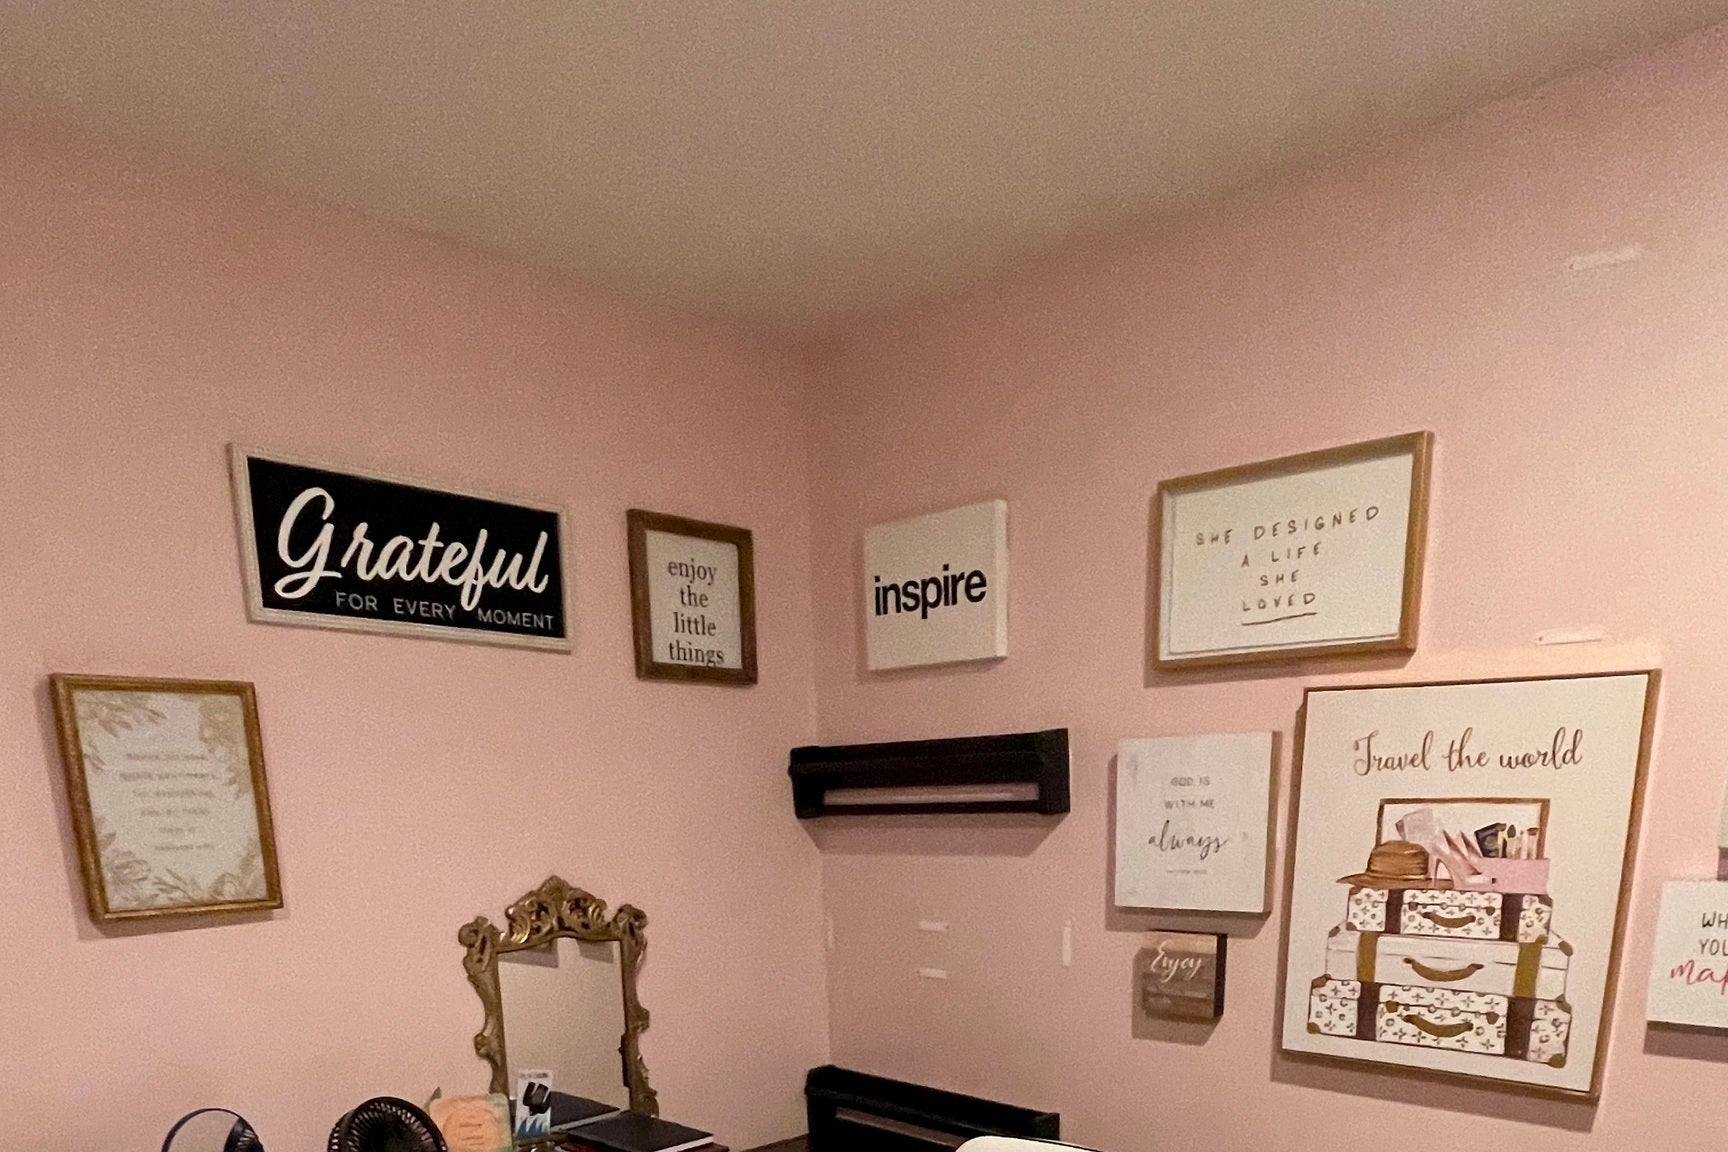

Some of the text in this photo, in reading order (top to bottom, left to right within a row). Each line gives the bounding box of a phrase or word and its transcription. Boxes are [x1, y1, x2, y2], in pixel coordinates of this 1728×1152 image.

[1195, 505, 1380, 546] SHE DESIGNED
[274, 486, 549, 611] Grateful
[1241, 542, 1322, 567] A LIFE
[667, 558, 717, 586] enjoy
[1259, 570, 1300, 586] SHE
[679, 585, 709, 608] the
[874, 563, 987, 620] inspire
[1242, 592, 1316, 612] LOVED
[335, 591, 555, 630] FOR EVERY MOMENT
[673, 611, 717, 637] little
[668, 639, 725, 667] things
[1352, 726, 1583, 776] Travel the world
[1170, 776, 1210, 787] GOD IS
[1164, 799, 1215, 809] WITH ME
[1148, 819, 1229, 861] always
[1701, 911, 1728, 929] WH
[1150, 939, 1202, 984] Enjoy
